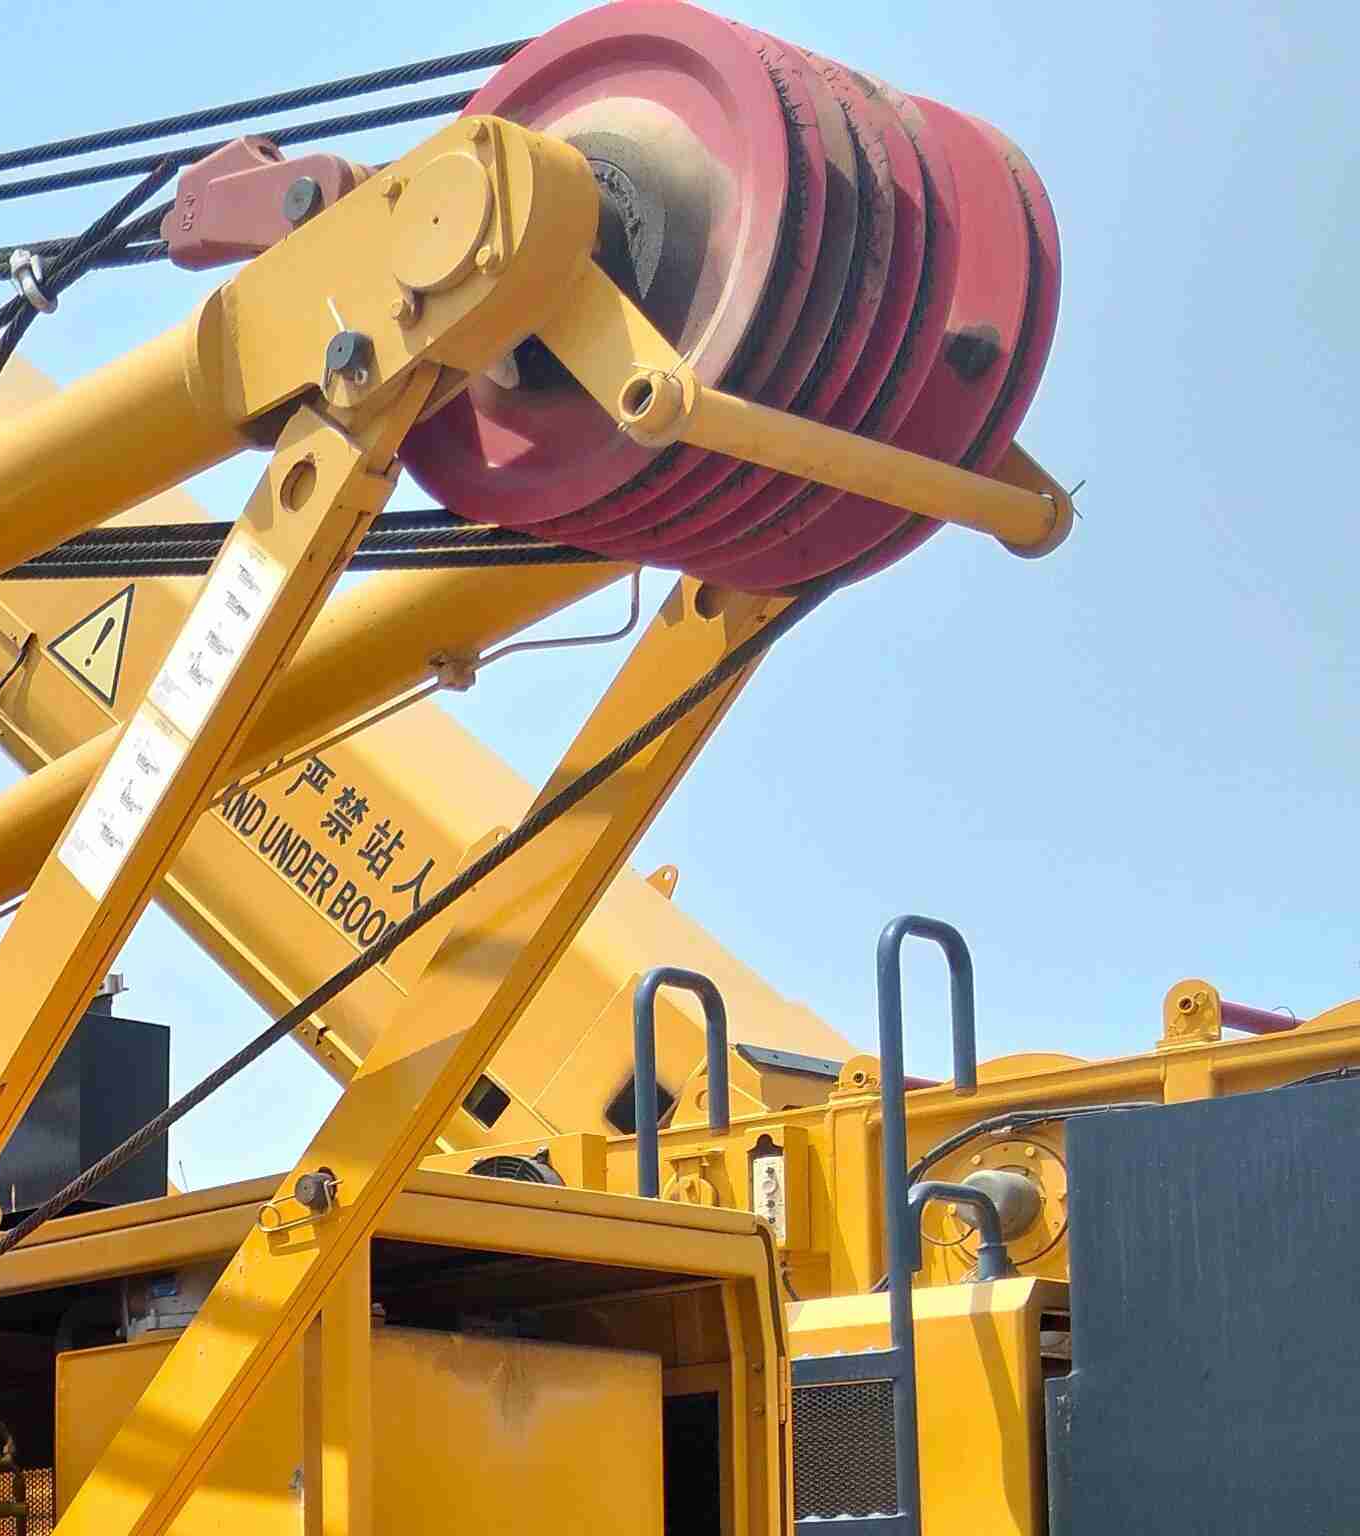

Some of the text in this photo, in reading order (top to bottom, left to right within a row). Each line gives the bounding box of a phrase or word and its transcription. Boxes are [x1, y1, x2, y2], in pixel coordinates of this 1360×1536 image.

[258, 815, 339, 906] UNDER
[284, 755, 436, 913] 严禁站人
